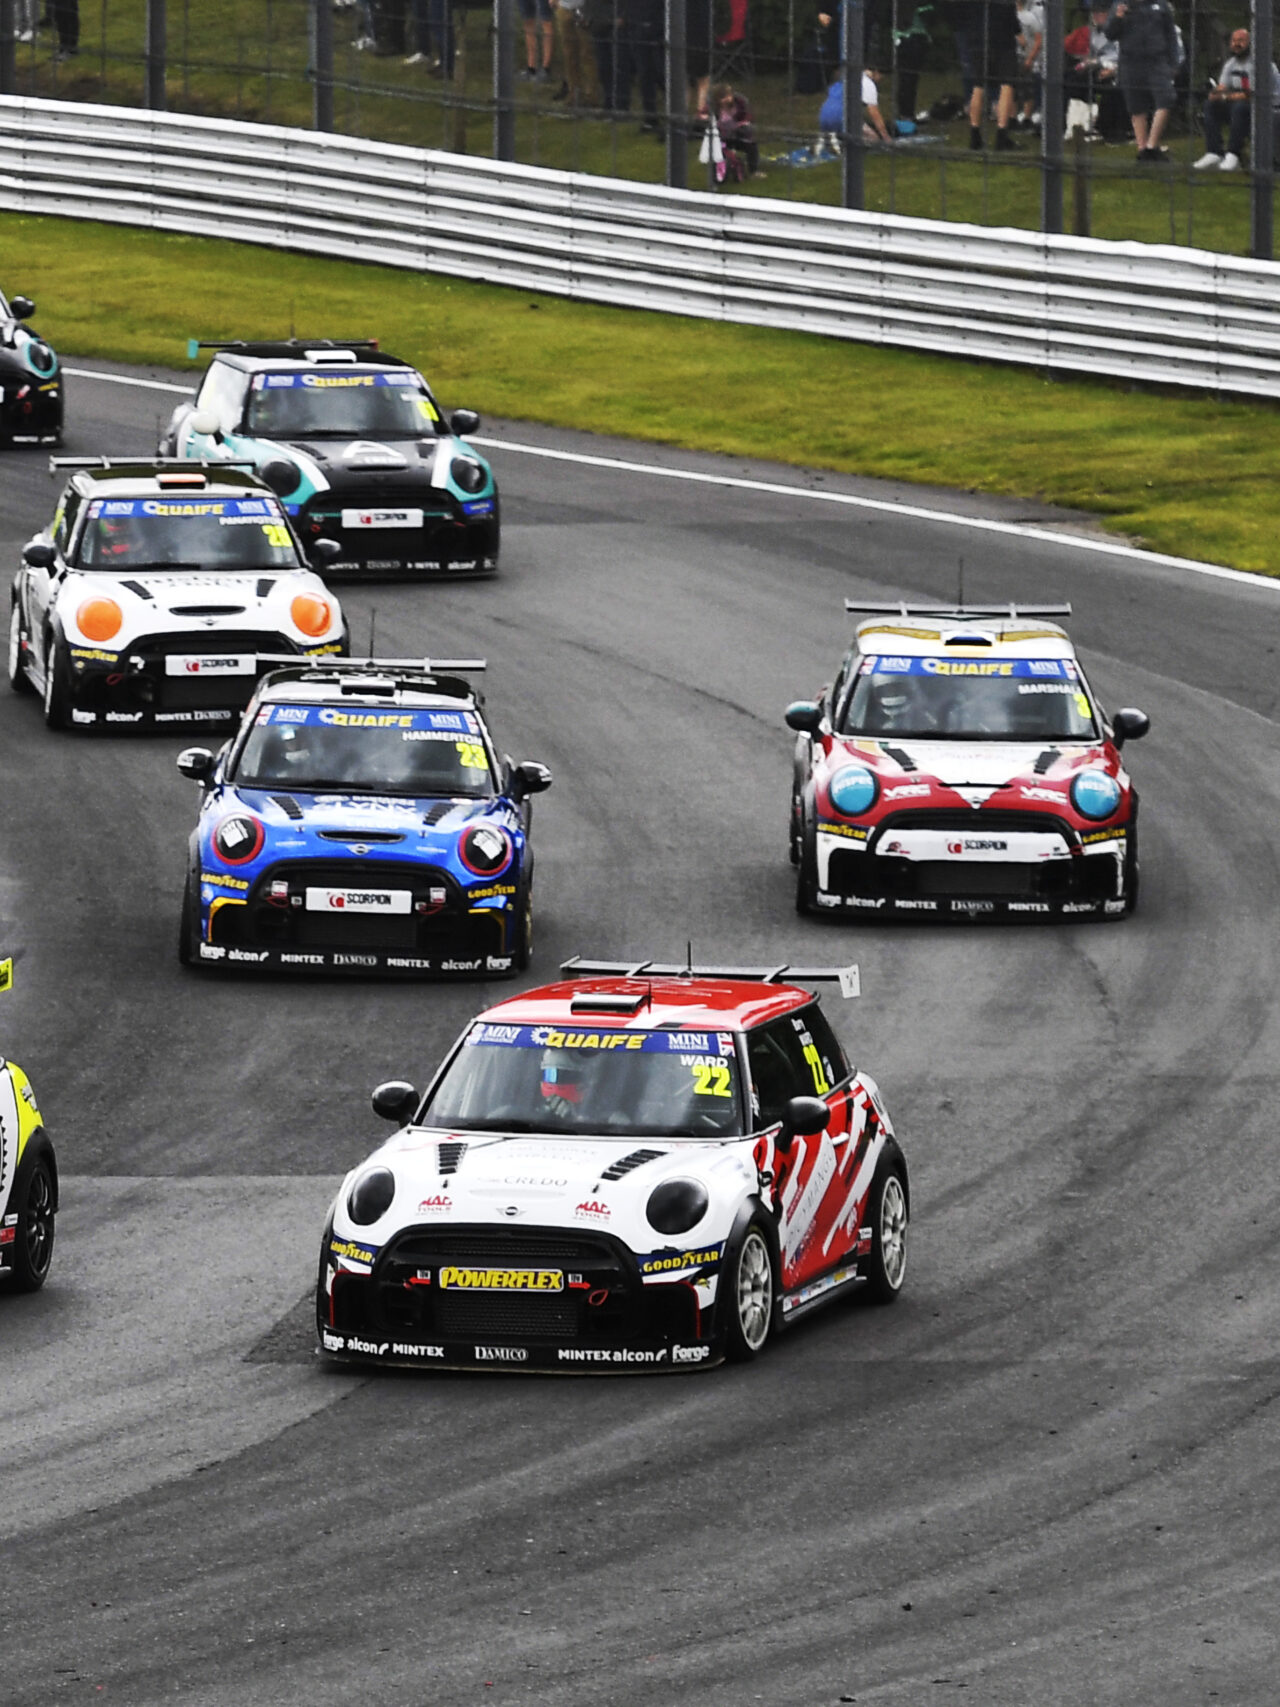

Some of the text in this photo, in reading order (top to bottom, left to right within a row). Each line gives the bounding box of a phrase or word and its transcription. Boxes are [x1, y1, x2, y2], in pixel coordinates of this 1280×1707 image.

[156, 503, 224, 516] QUAIFE
[935, 661, 1014, 676] QUAIFE
[332, 712, 414, 728] QUAIFE
[402, 730, 483, 746] HAMMERTON
[346, 892, 392, 906] SCORPION
[281, 953, 325, 965] MINTEX
[387, 958, 431, 969] MINTEX
[486, 1027, 709, 1049] MINI QUAIFE MINI
[679, 1054, 729, 1068] WARD
[691, 1064, 732, 1098] 22
[503, 1175, 568, 1187] CREDO
[642, 1250, 719, 1273] GOODYEAR
[440, 1266, 563, 1290] POWERFLEX
[347, 1337, 378, 1353] alcon
[392, 1343, 445, 1358] MINTEX
[474, 1346, 529, 1361] DAMICO
[558, 1349, 612, 1362] MINTEX
[613, 1348, 657, 1362] alcon
[672, 1345, 710, 1363] forge
